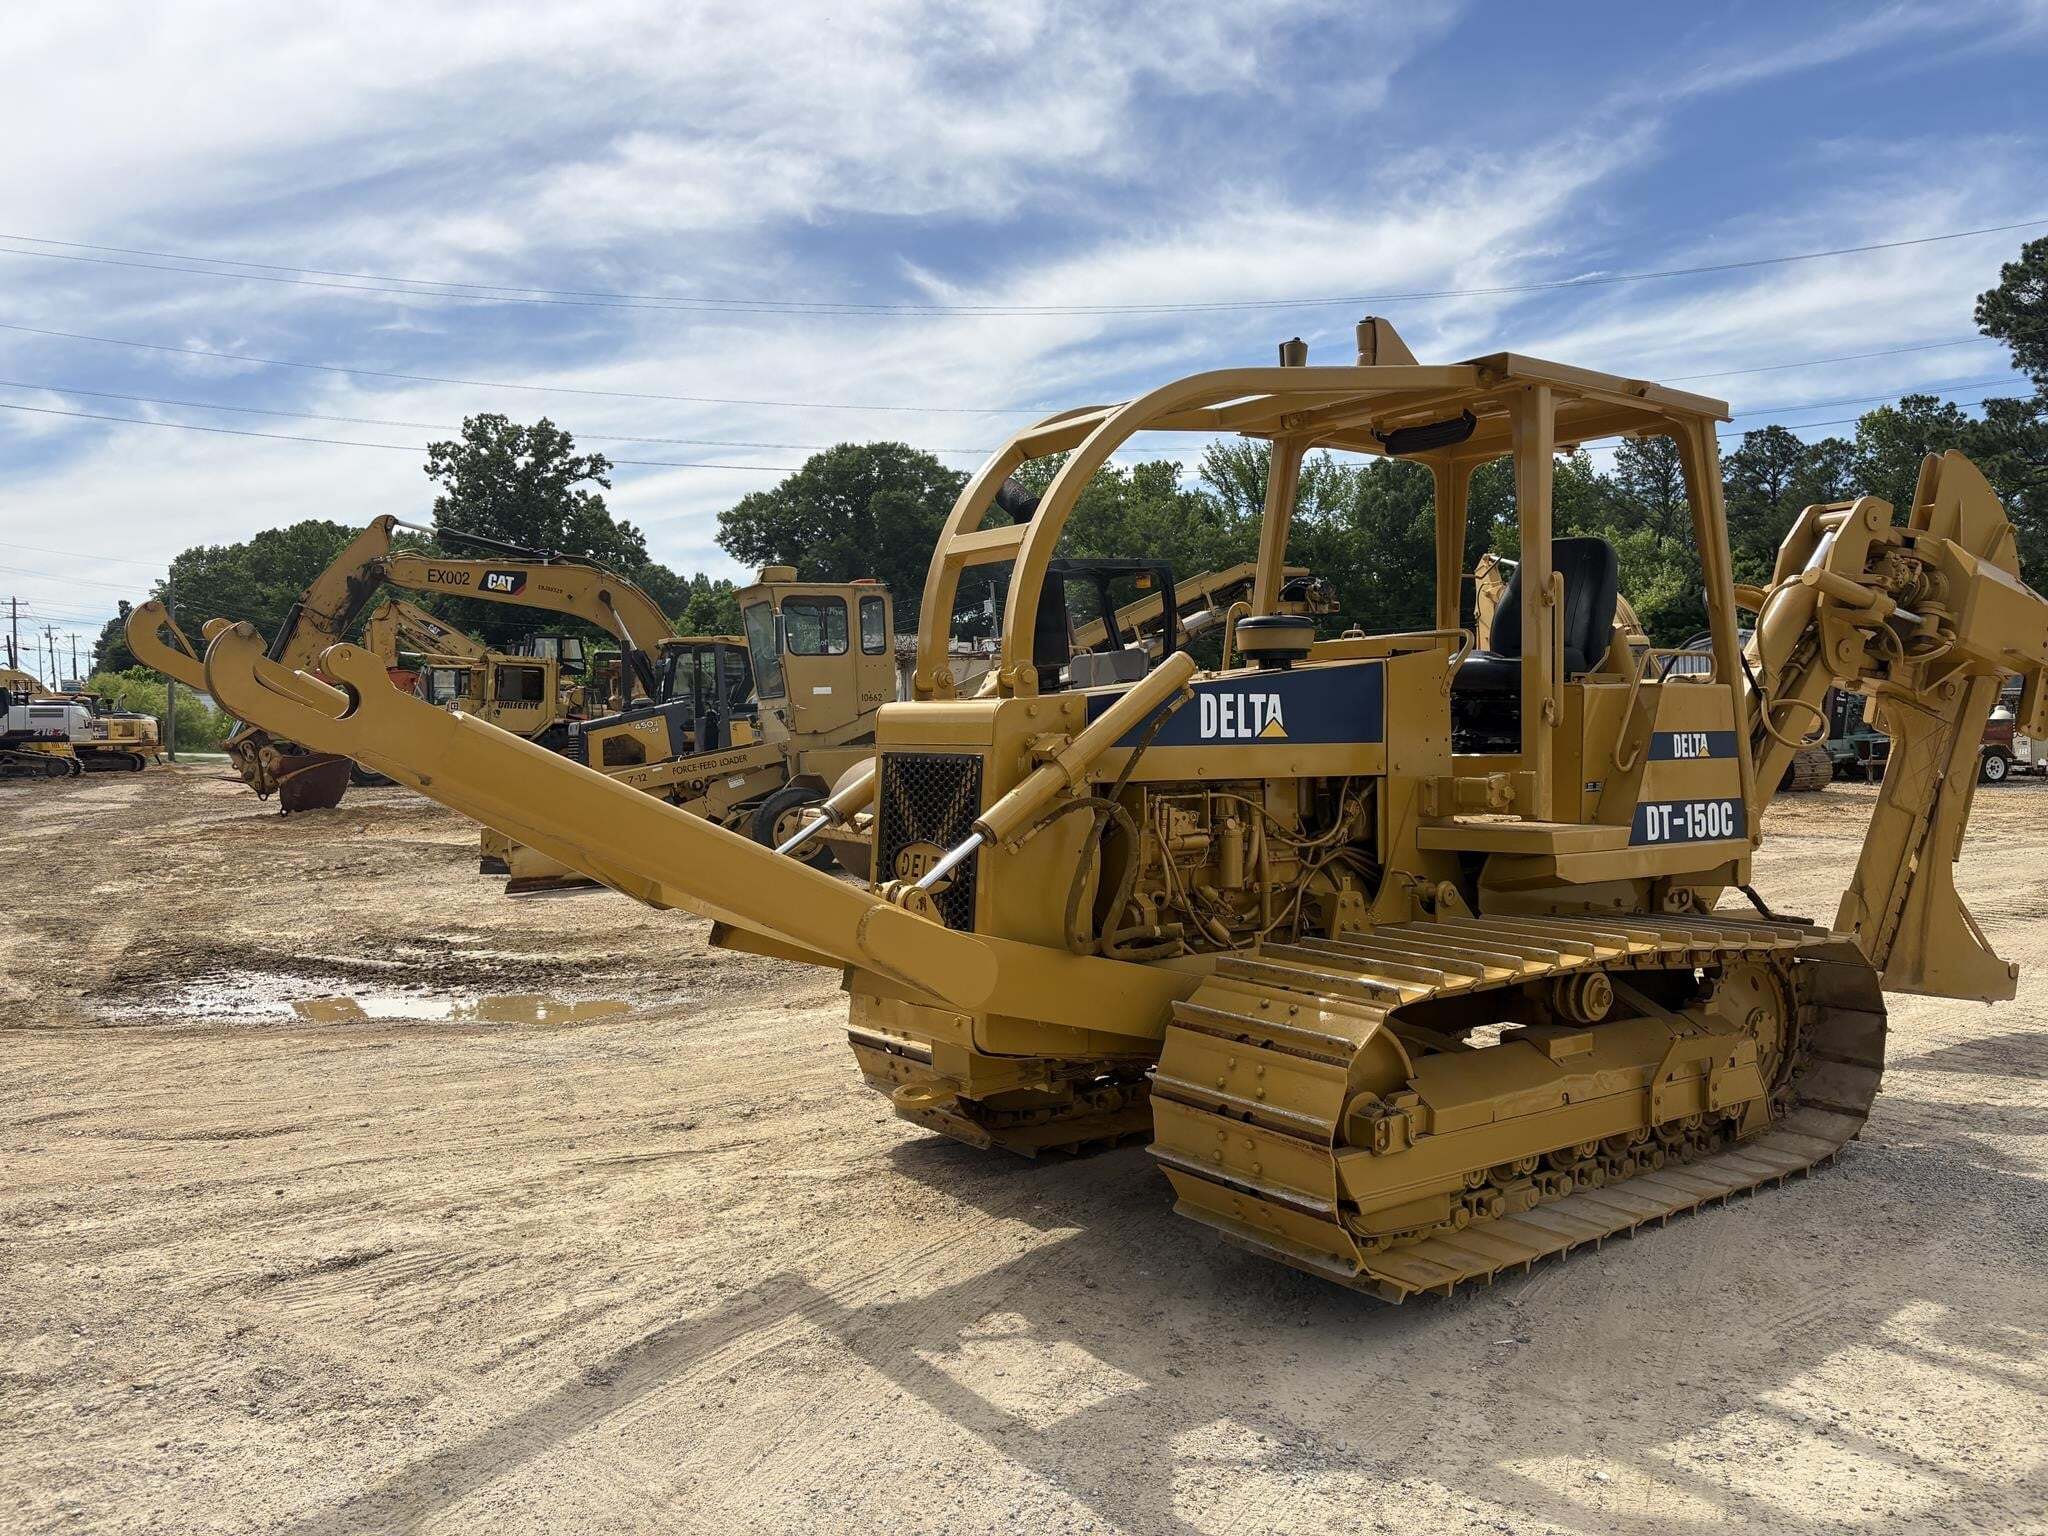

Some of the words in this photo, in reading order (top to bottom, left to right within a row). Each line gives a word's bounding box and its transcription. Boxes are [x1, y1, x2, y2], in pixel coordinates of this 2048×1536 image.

[427, 568, 470, 586] EX002
[487, 573, 514, 592] CAT
[428, 623, 441, 636] CAT
[498, 700, 539, 711] UNISERVE
[861, 693, 883, 702] 10662
[1200, 693, 1286, 738] DELTA
[1673, 733, 1710, 758] DELTA
[672, 760, 717, 776] FORCE-FEED
[719, 754, 748, 767] LOADER
[627, 773, 648, 784] 7-12
[1646, 801, 1734, 841] DT-150C
